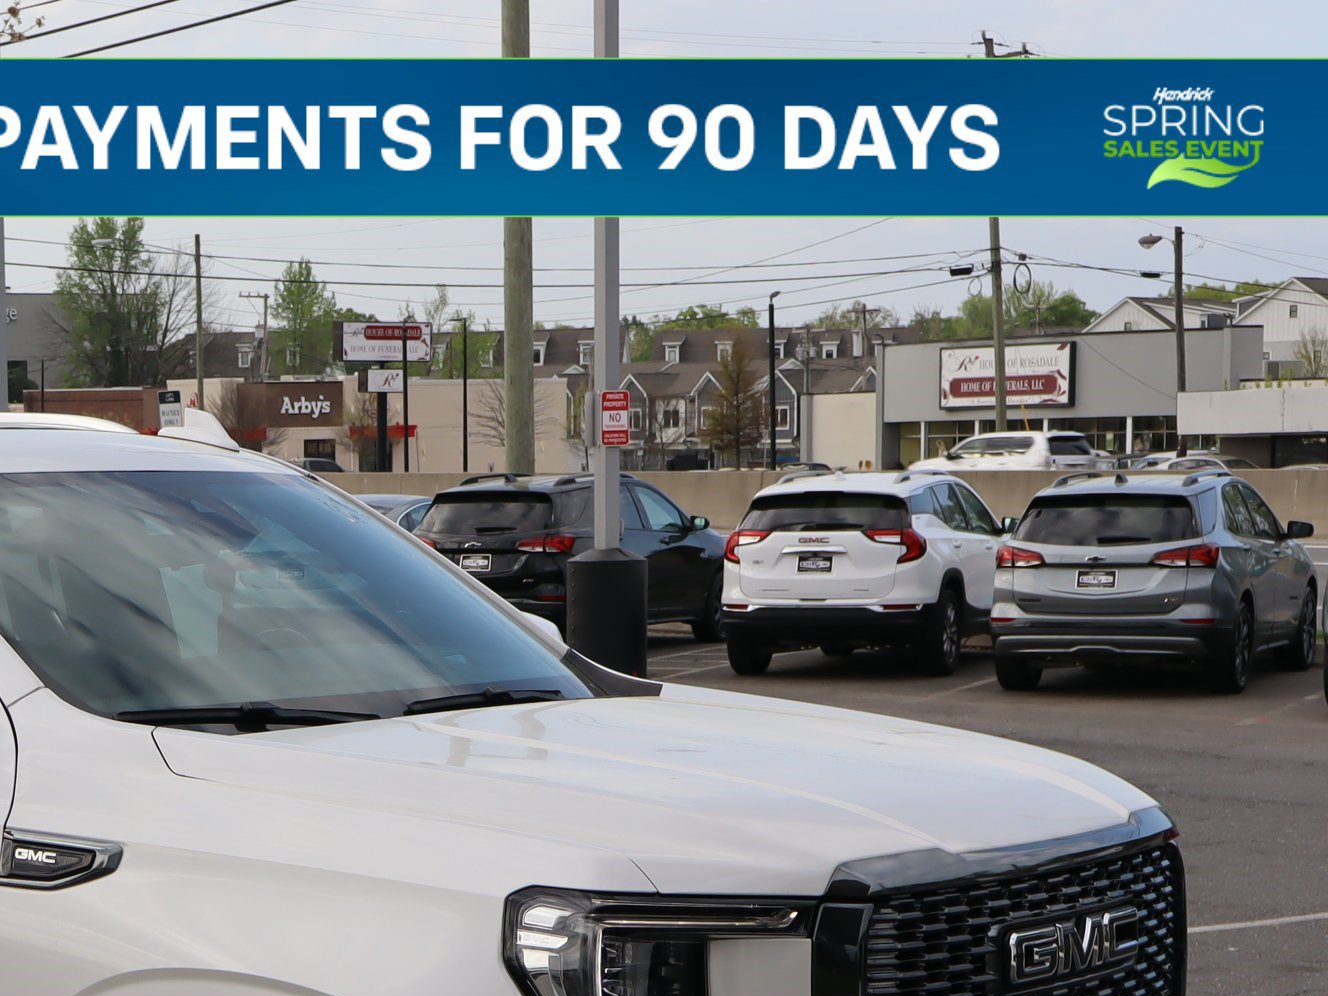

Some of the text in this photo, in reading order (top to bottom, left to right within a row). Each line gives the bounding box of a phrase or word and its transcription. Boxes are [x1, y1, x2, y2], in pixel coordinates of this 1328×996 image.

[979, 359, 995, 371] HOU
[960, 381, 981, 393] HOME
[981, 381, 992, 391] OF
[1031, 379, 1045, 390] LLC
[280, 395, 331, 418] Arby's
[609, 412, 622, 423] NO
[14, 847, 57, 864] GMC
[1009, 905, 1139, 985] GMC
